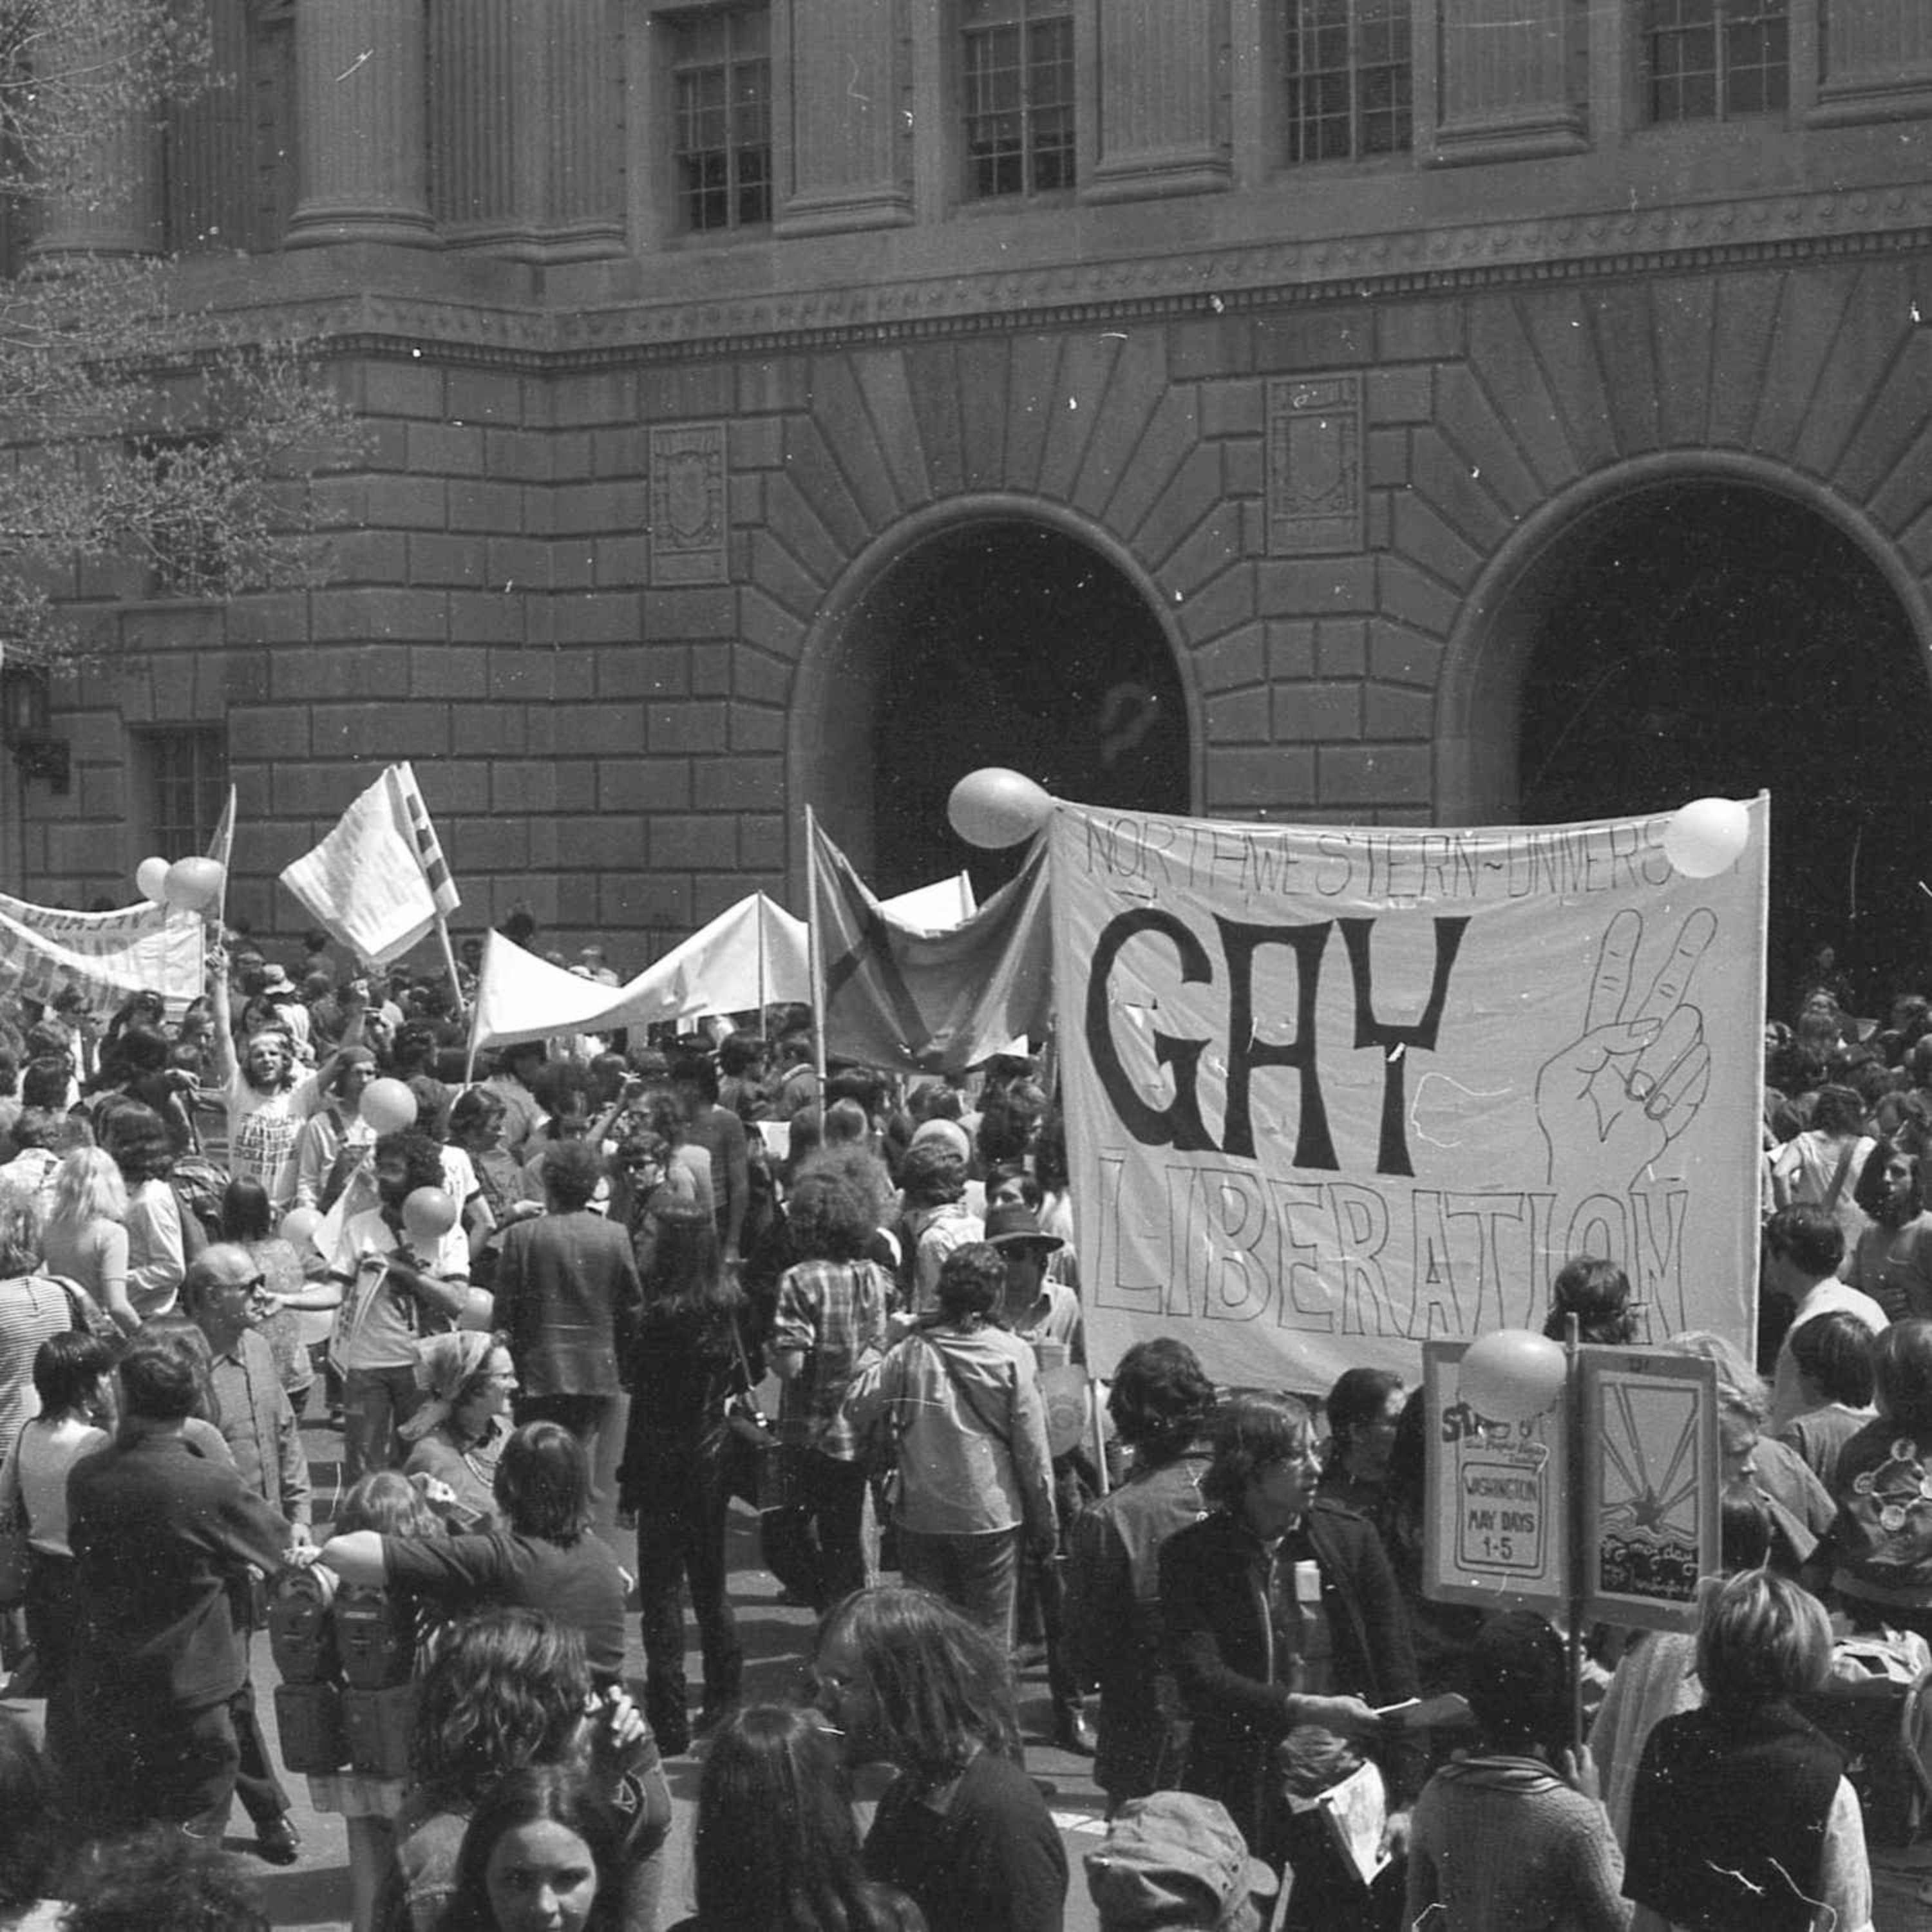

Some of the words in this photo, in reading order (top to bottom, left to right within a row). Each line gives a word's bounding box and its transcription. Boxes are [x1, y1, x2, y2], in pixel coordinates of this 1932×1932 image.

[1084, 817, 1480, 896] NORTHWESTERN
[1508, 817, 1739, 897] UNIVERS
[1084, 907, 1473, 1177] GAY
[1468, 1510, 1497, 1531] MAY
[1501, 1511, 1535, 1533] DAYS
[1482, 1536, 1513, 1560] 1-5
